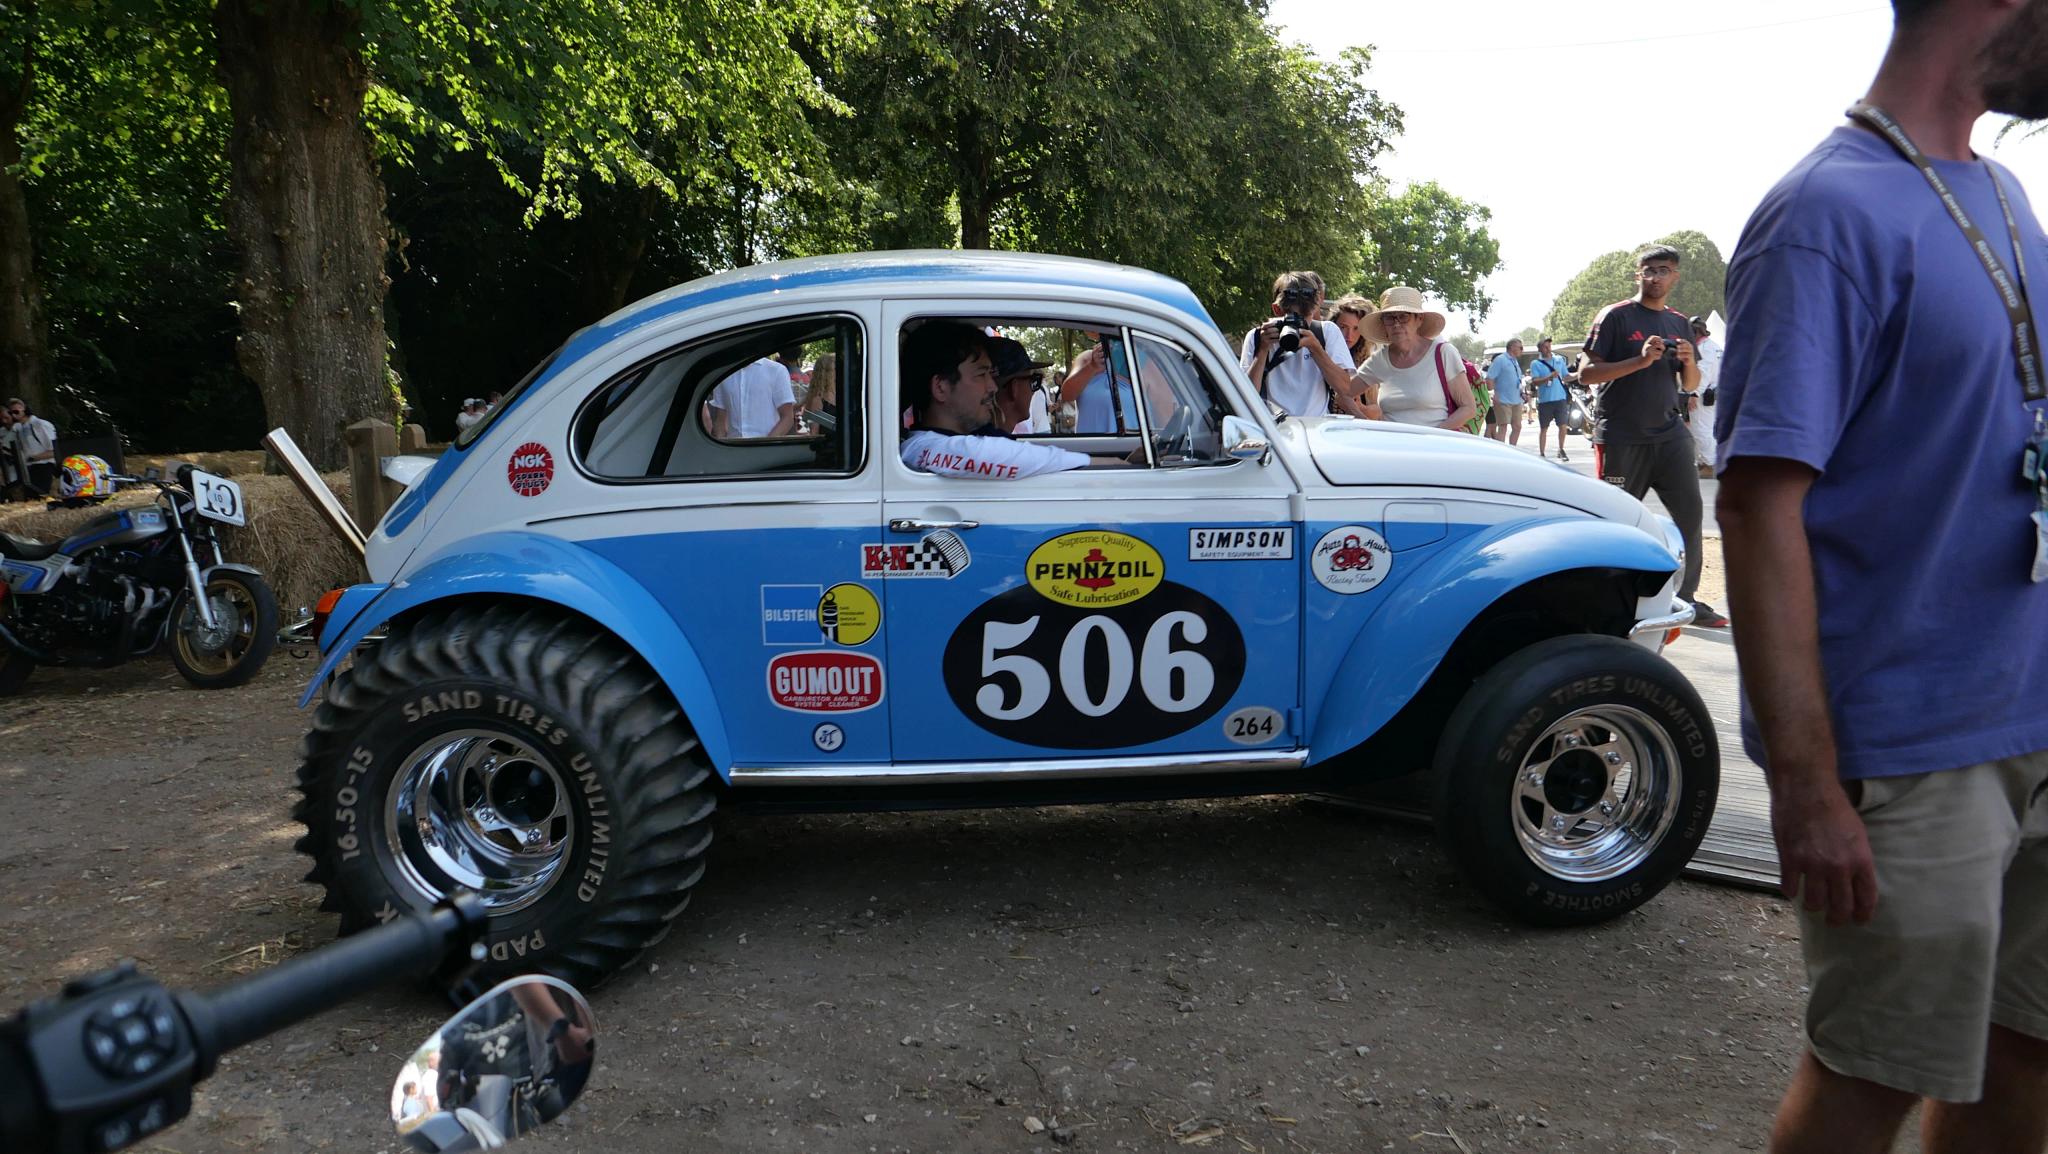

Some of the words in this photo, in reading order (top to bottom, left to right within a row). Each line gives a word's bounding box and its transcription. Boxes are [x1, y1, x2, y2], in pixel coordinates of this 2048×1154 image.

[514, 453, 546, 469] NGK
[1056, 535, 1100, 549] Supreme
[1101, 534, 1137, 551] Quality
[1196, 531, 1285, 549] SIMPSON
[1035, 561, 1155, 580] PENNZOIL
[1050, 585, 1073, 601] Safe
[1075, 587, 1140, 604] Lubrication
[765, 608, 817, 622] BILSTEIN
[975, 610, 1215, 720] 506
[775, 666, 875, 695] GUMOUT
[1232, 715, 1275, 738] 264
[1496, 707, 1544, 763] SAND
[1550, 675, 1616, 705] TIRES
[1624, 676, 1706, 758] UNLIMITED
[336, 746, 374, 861] 16.50-15
[402, 690, 482, 722] SAND
[496, 695, 568, 745] TIRES
[570, 752, 610, 903] UNLIMITED
